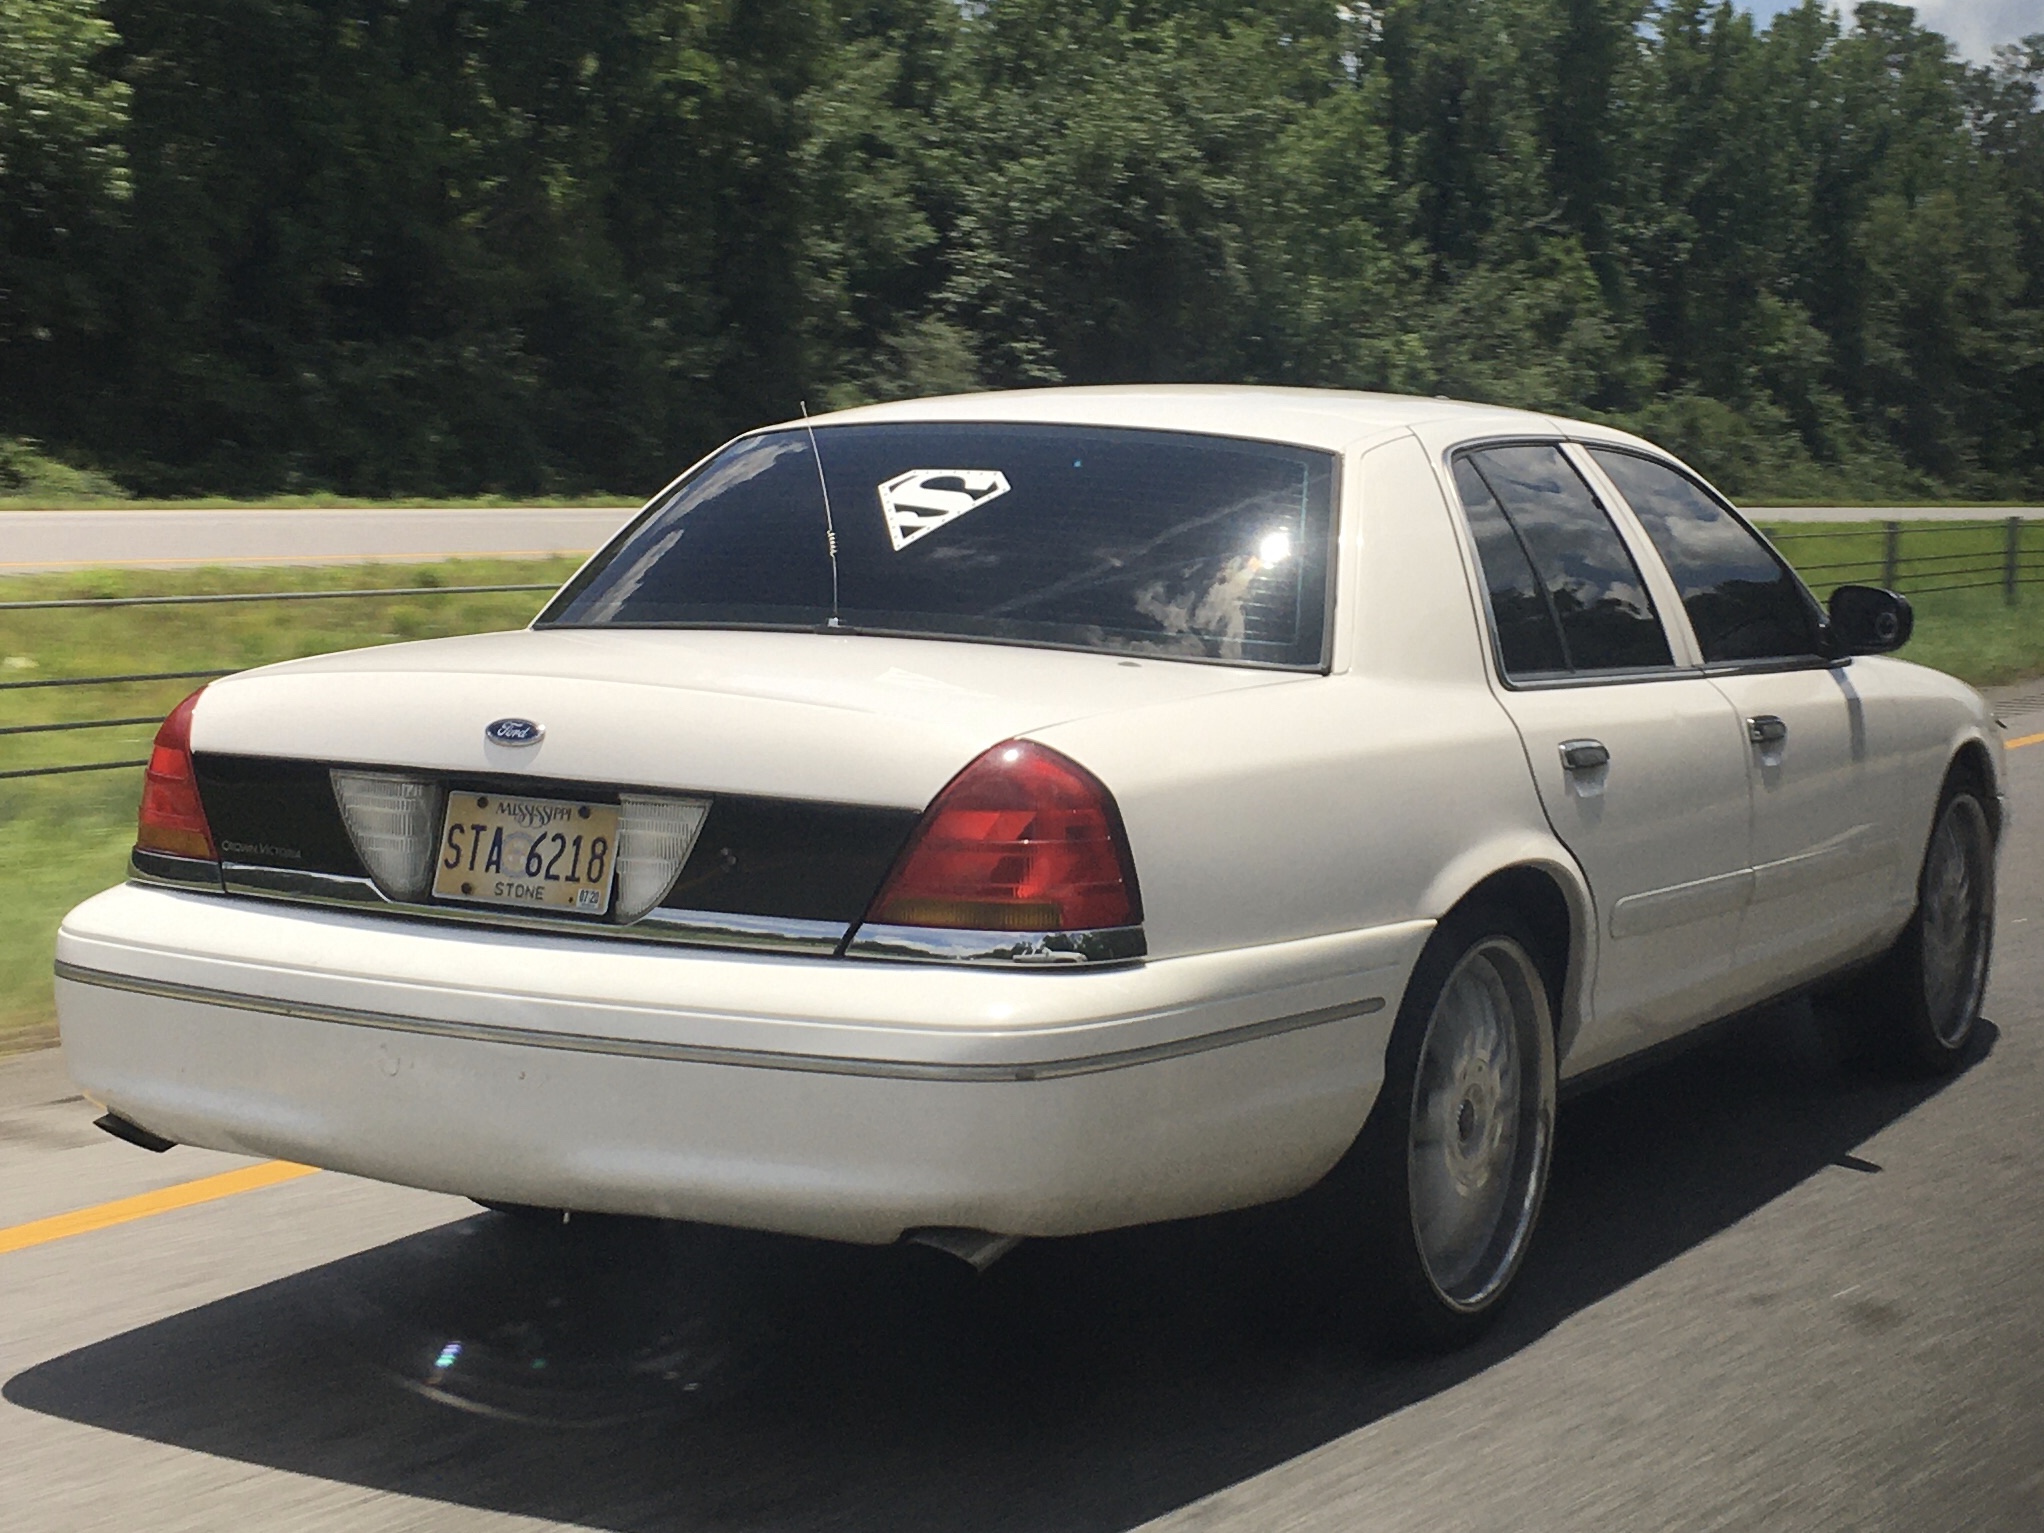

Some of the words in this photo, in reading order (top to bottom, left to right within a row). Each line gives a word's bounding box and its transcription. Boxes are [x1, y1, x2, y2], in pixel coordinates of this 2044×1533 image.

[496, 720, 531, 738] Ford
[495, 802, 572, 829] MISSISSIPPI
[444, 823, 504, 874] STA
[525, 831, 608, 884] 6218
[494, 882, 546, 900] STONE
